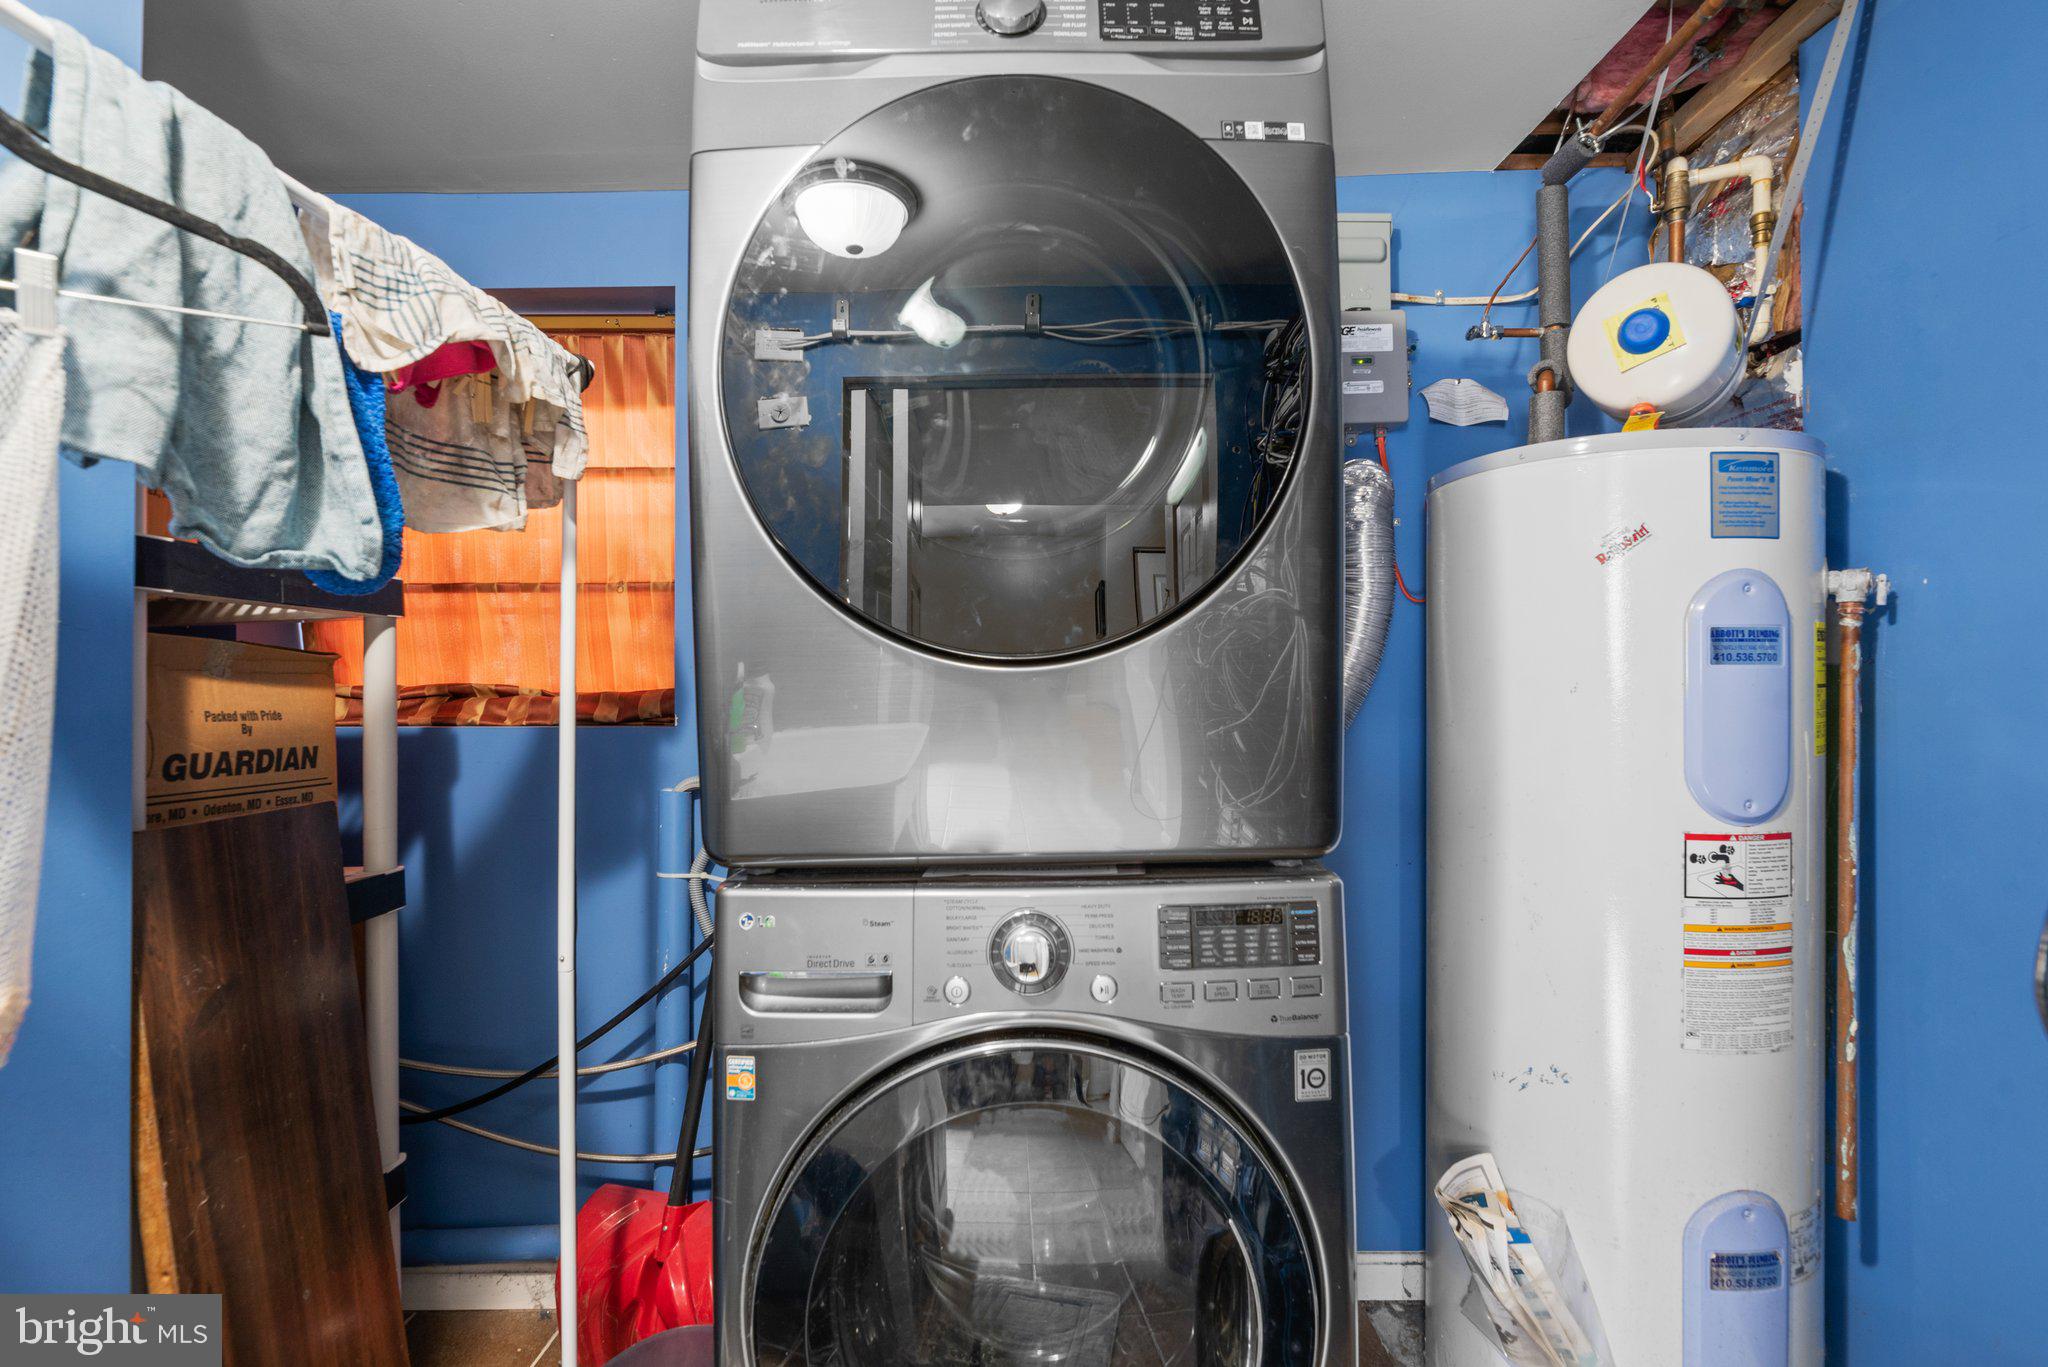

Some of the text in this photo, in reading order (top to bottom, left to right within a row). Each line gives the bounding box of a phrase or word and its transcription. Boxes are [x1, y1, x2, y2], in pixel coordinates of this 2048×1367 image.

[1340, 325, 1356, 336] GE
[1728, 463, 1774, 472] Kenmore
[1712, 652, 1778, 663] 410.536.5700
[204, 709, 283, 722] Packed with Pride
[242, 724, 253, 736] By
[162, 745, 319, 783] GUARDIAN
[169, 808, 186, 821] MD
[247, 799, 261, 810] MD
[301, 791, 314, 803] MD
[1301, 1068, 1325, 1089] 10
